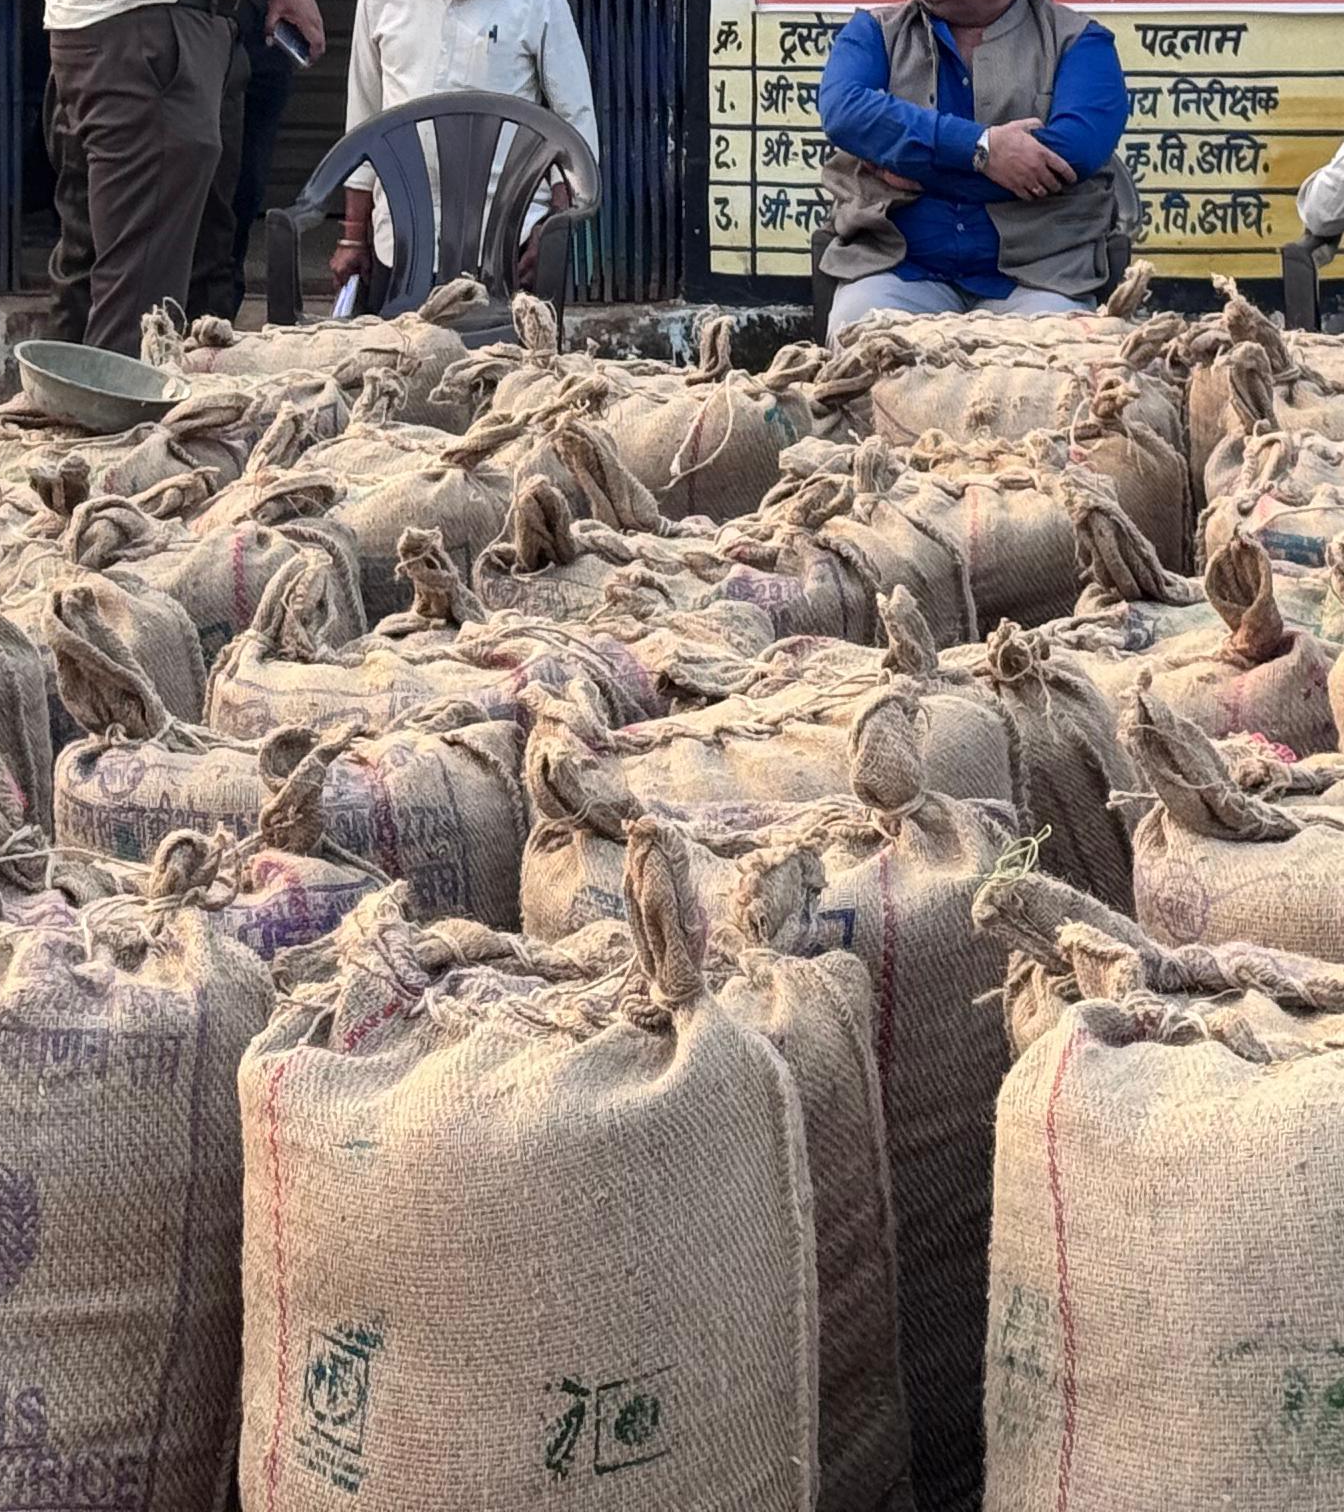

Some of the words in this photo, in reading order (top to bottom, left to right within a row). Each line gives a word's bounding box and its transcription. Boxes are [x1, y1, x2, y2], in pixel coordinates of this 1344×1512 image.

[713, 20, 743, 55] क्र.
[1135, 23, 1248, 61] पदनाम
[716, 80, 736, 113] 1.
[1167, 78, 1279, 122] निरीक्षक
[715, 138, 737, 169] 2.
[714, 197, 739, 230] 3.
